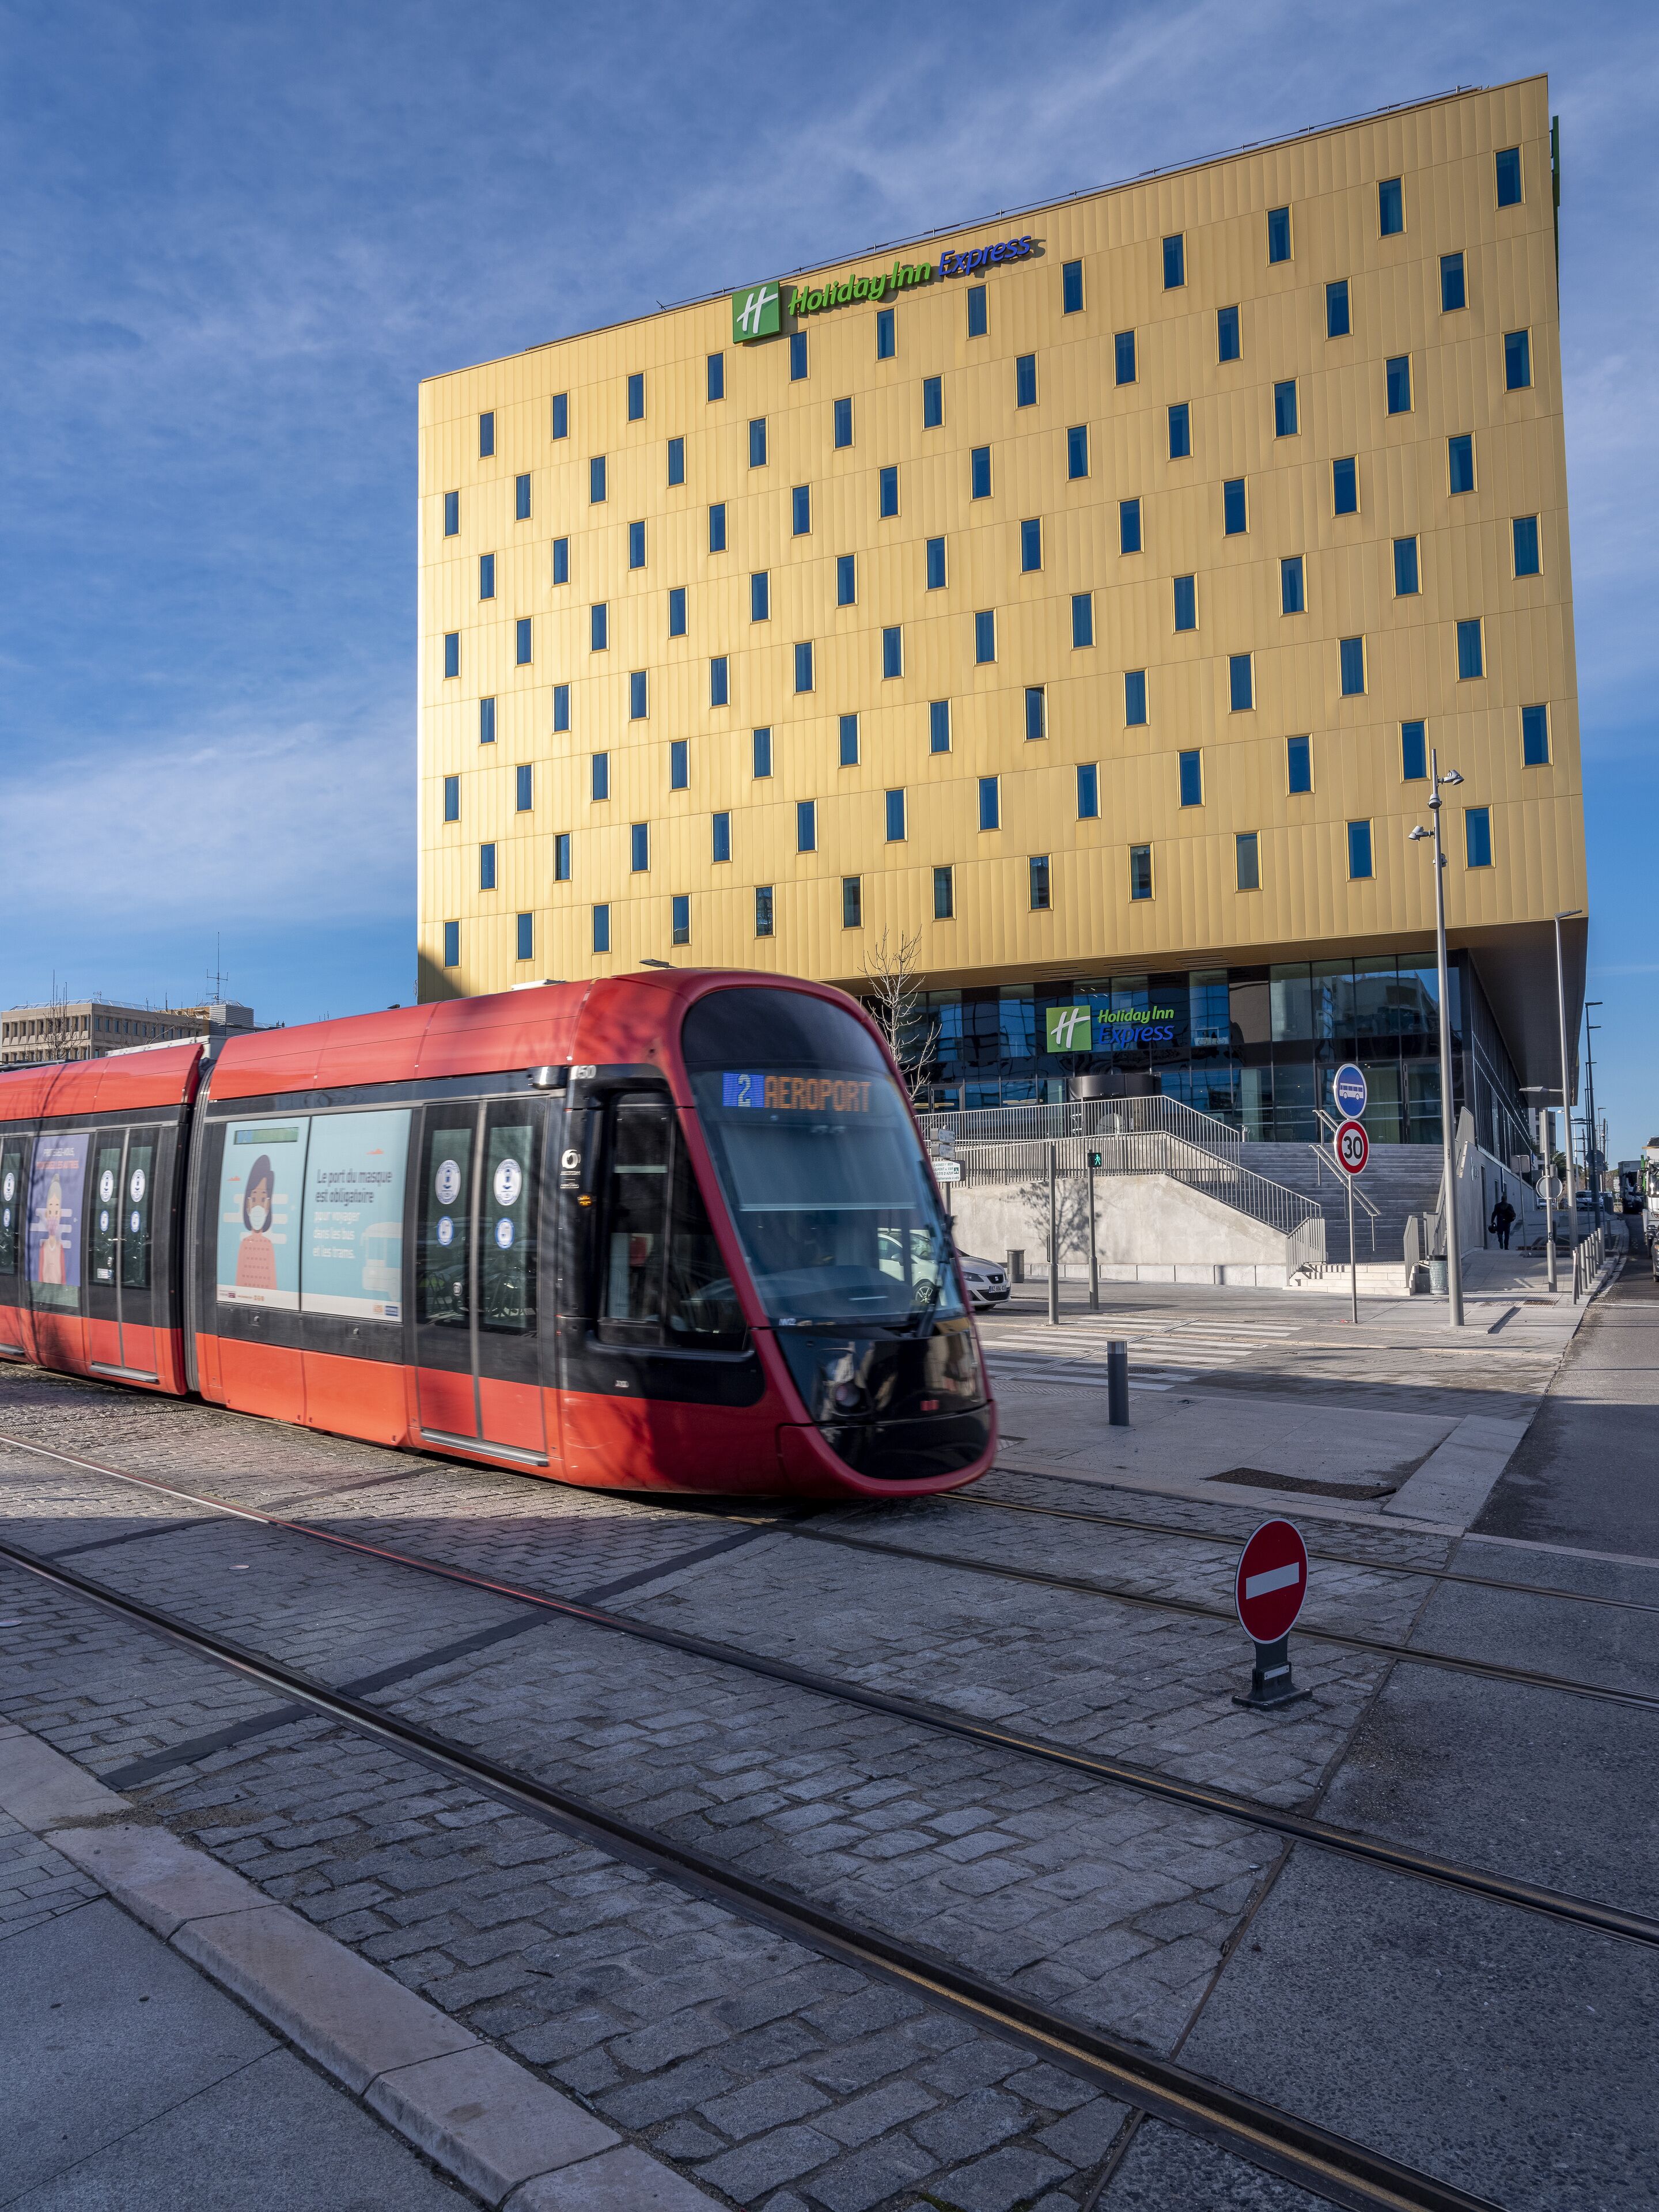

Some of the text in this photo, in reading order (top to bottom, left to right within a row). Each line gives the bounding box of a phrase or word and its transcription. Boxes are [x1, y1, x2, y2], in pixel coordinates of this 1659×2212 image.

[788, 236, 1031, 316] Holiday Inn Express
[1097, 1006, 1174, 1024] Holiday Inn
[1099, 1025, 1175, 1048] Express
[738, 1074, 872, 1112] 2 AEROPORT
[1343, 1136, 1363, 1159] 30
[317, 1168, 393, 1187] Le port du masque
[315, 1187, 374, 1207] est obligatoire
[313, 1211, 361, 1225] pour voyager
[313, 1226, 355, 1240] dans les bus
[313, 1245, 321, 1257] et
[321, 1245, 331, 1257] les
